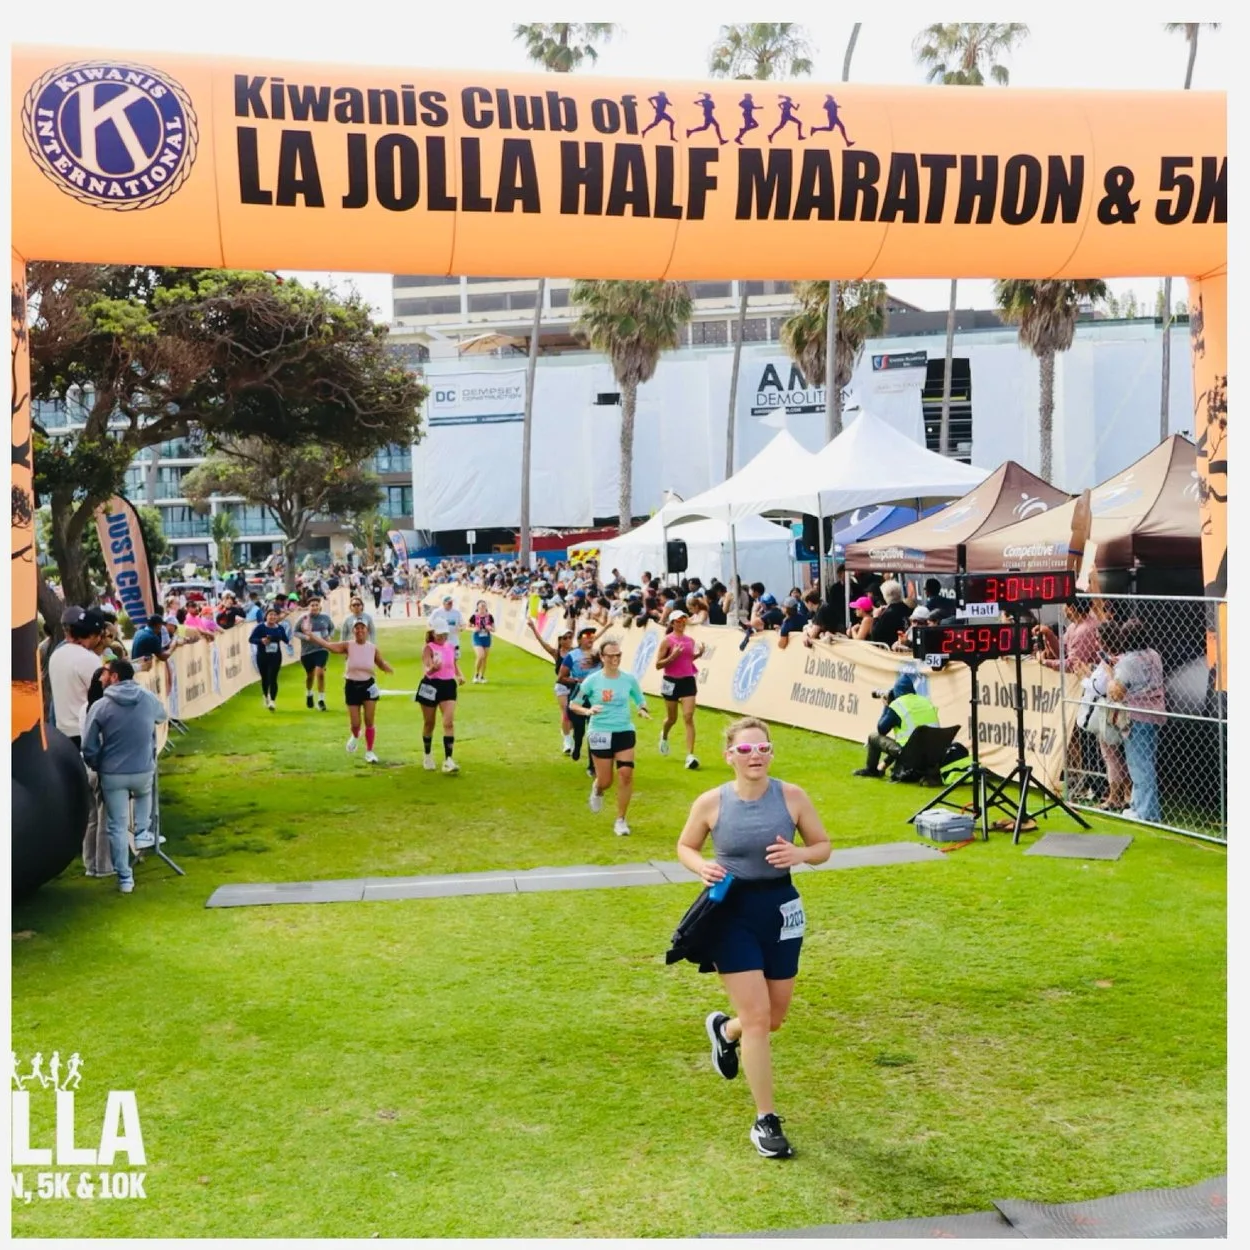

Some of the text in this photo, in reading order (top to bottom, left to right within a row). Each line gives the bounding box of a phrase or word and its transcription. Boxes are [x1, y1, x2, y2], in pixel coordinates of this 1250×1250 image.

[55, 69, 167, 98] KIWANIS
[234, 74, 638, 135] Kiwanis Club of
[77, 80, 153, 178] K
[38, 108, 182, 196] INTERNATIONAL
[237, 126, 325, 208] LA
[342, 132, 541, 213] JOLLA
[560, 140, 719, 220] HALF
[735, 148, 1084, 225] MARATHON
[1097, 165, 1141, 225] &
[436, 390, 456, 403] DC
[462, 386, 521, 397] DEMPSEY
[757, 388, 853, 406] DEMOLITIN
[106, 513, 135, 564] JUST
[1003, 544, 1054, 559] Competitive
[115, 570, 148, 631] CRUI
[971, 605, 995, 616] Half
[804, 656, 815, 675] La
[816, 658, 836, 679] Jolla
[926, 655, 940, 667] 5k
[790, 682, 838, 710] Marathon
[1032, 685, 1062, 714] Half
